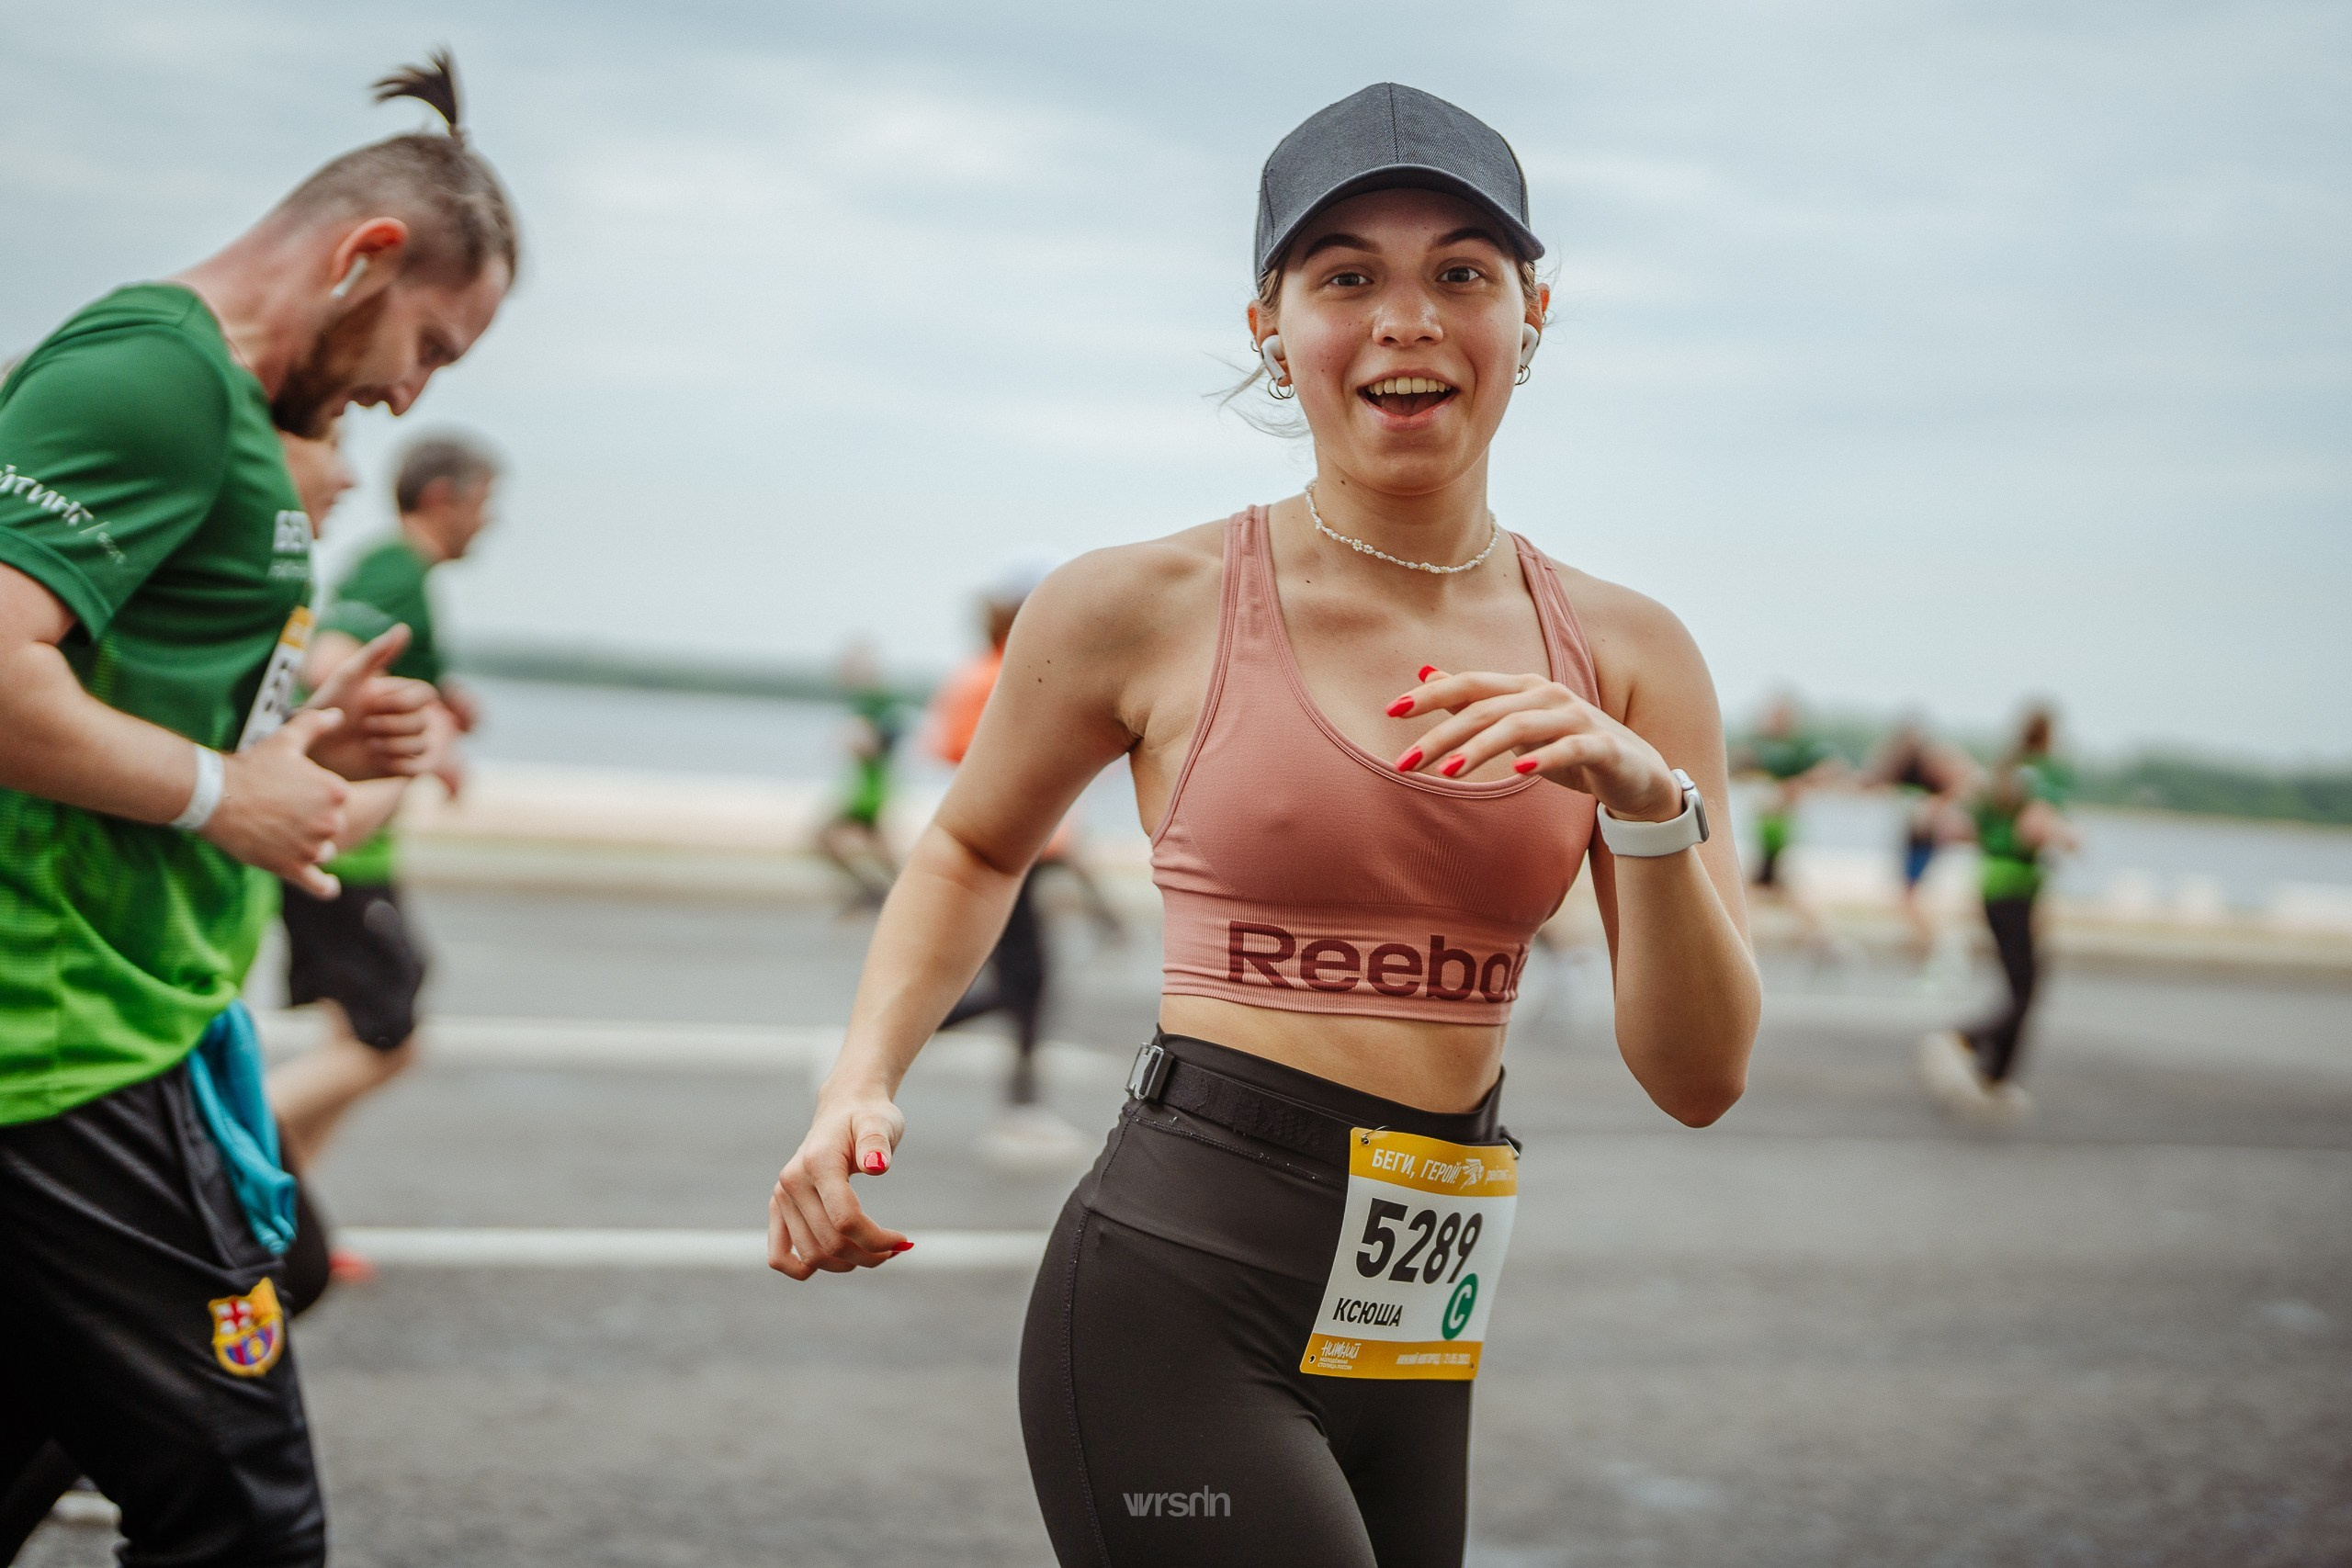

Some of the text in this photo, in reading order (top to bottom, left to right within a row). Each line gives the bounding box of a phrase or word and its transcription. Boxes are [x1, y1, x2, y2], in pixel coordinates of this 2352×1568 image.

[1372, 1148, 1416, 1179] БЕГИ,
[1420, 1158, 1463, 1184] ГЕРОЙ!
[1355, 1197, 1483, 1284] 5289
[1333, 1298, 1404, 1327] КСЮША
